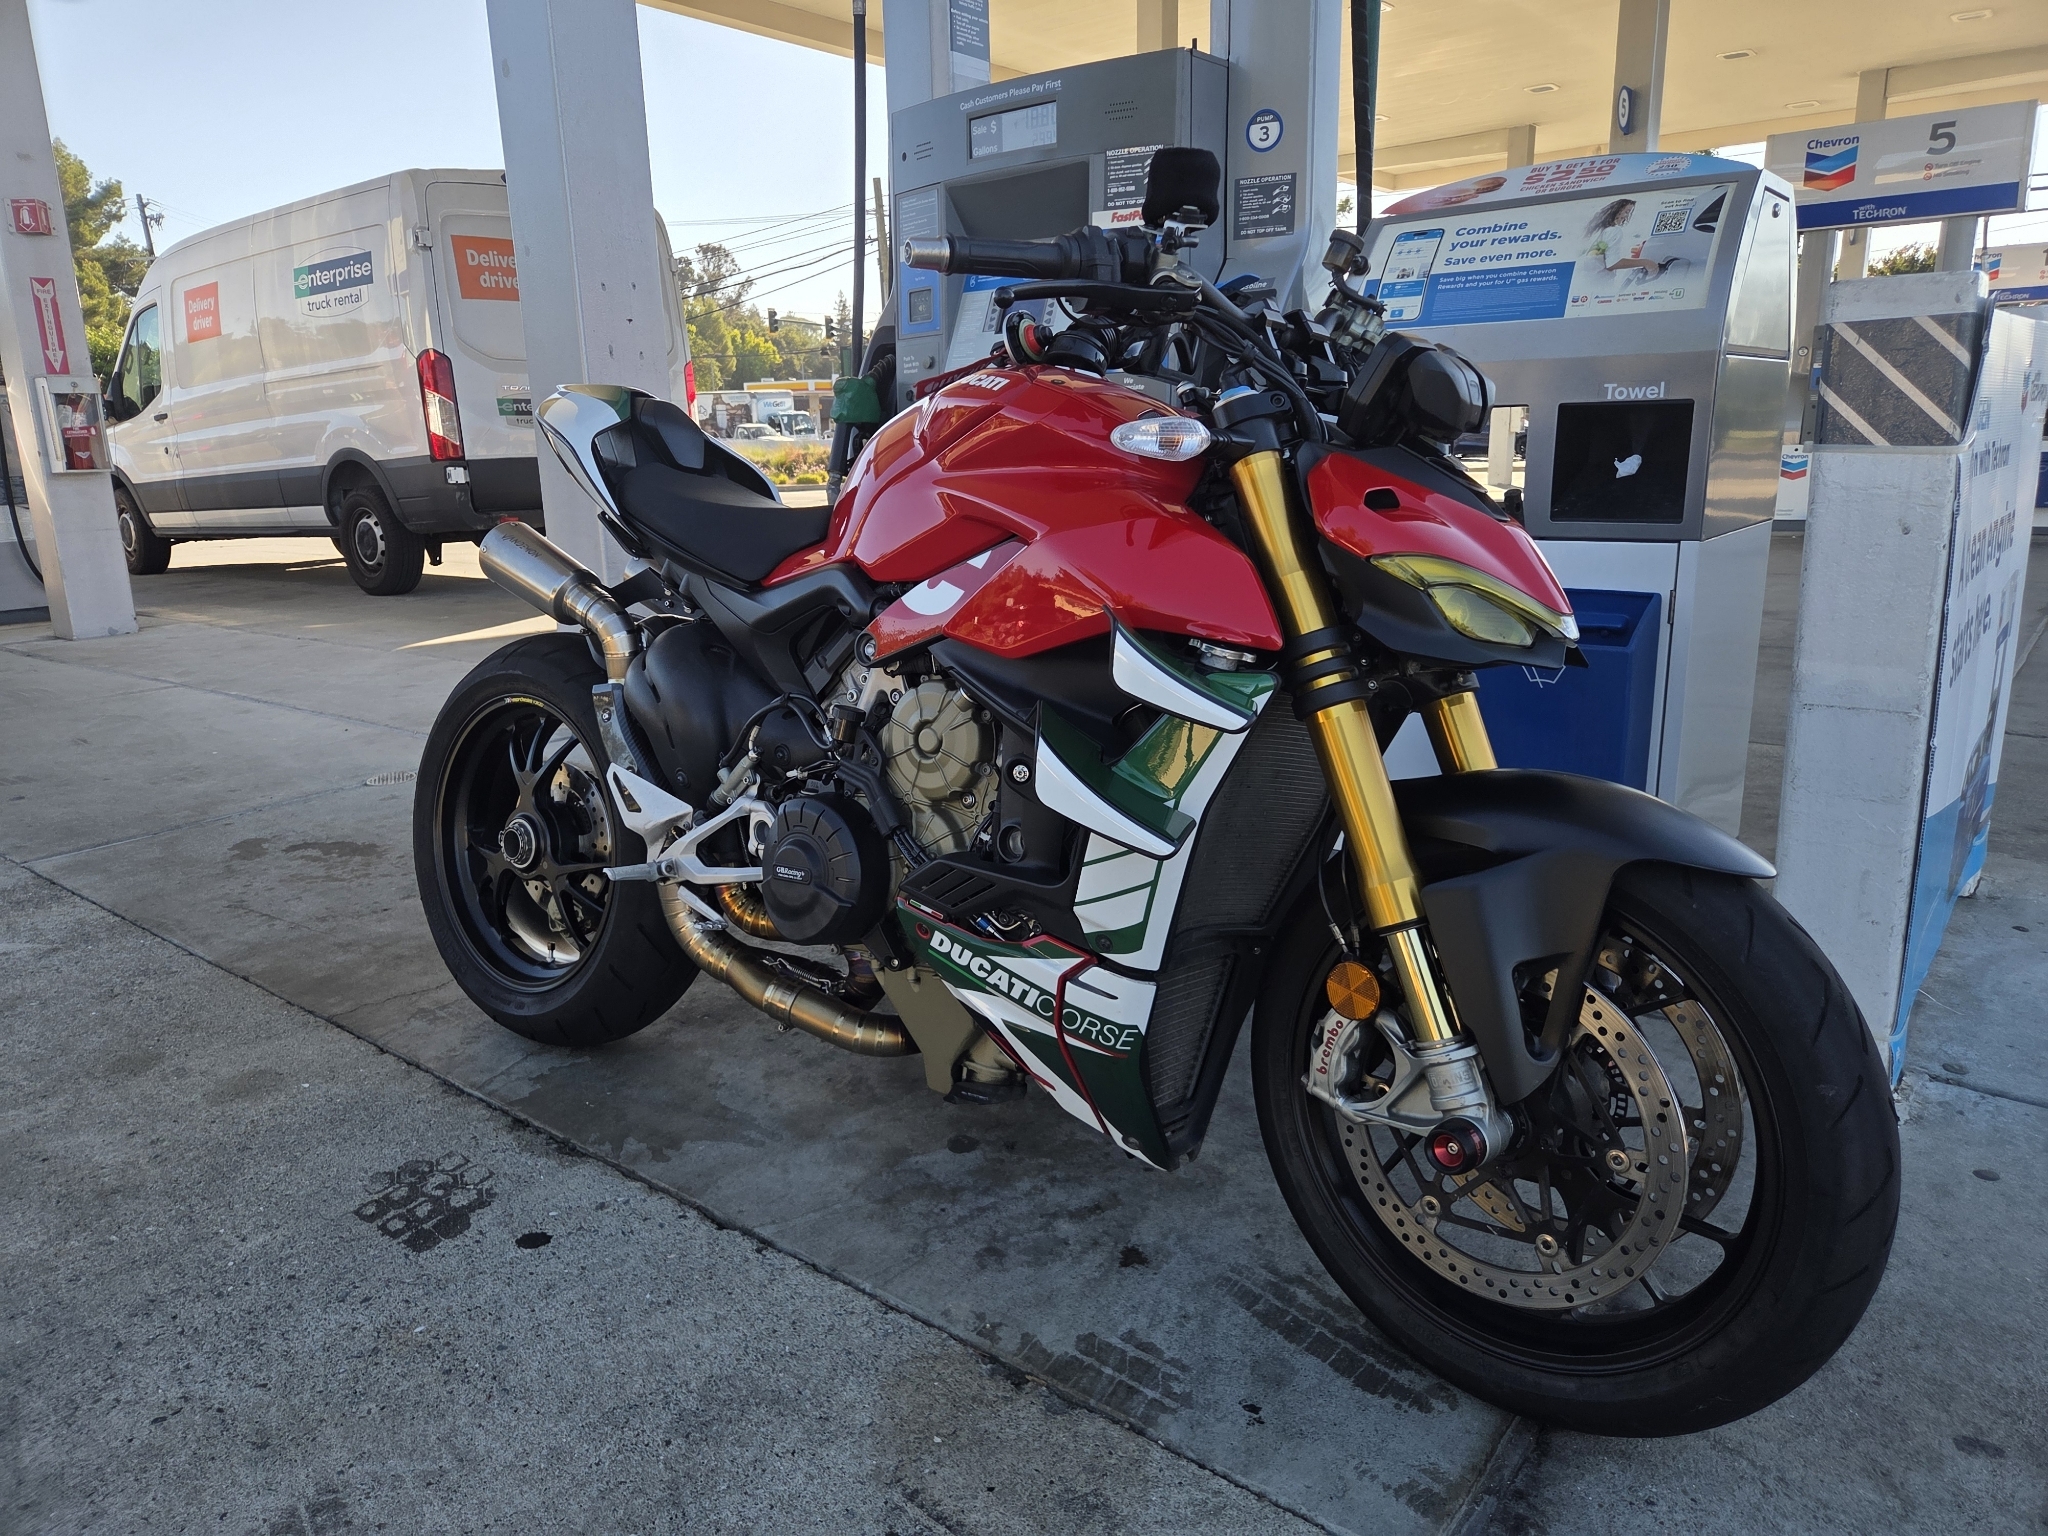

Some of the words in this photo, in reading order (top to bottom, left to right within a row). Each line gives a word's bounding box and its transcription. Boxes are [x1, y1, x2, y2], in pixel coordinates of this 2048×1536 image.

[960, 100, 974, 110] Cash
[975, 90, 1008, 105] Customers
[1010, 88, 1030, 97] Please
[1032, 84, 1044, 92] Pay
[1045, 80, 1061, 89] First
[973, 125, 987, 135] Sale
[990, 120, 997, 134] $
[1258, 126, 1269, 142] 3
[1807, 136, 1859, 150] Chevron
[1926, 120, 1957, 155] 5
[973, 144, 998, 156] Gallons
[1107, 148, 1129, 156] NOZZLE
[1130, 144, 1164, 154] OPERATION
[1519, 182, 1556, 192] CHICKEN
[1557, 177, 1606, 187] SANDWICH
[1548, 184, 1582, 192] BURGER
[1852, 207, 1907, 219] TECHRON
[1455, 222, 1528, 237] Combine
[1449, 239, 1487, 252] your
[1490, 230, 1562, 246] rewards.
[466, 249, 517, 268] Delive
[1444, 256, 1476, 266] Save
[1480, 252, 1512, 263] even
[1516, 249, 1557, 259] more.
[295, 261, 372, 290] enterprise
[479, 271, 519, 289] drive
[1437, 282, 1464, 290] Rewards
[1530, 275, 1559, 283] rewards.
[188, 296, 215, 314] Delivery
[307, 295, 332, 312] truck
[334, 288, 362, 307] rental
[43, 298, 59, 363] EXTINGUISHER
[192, 315, 213, 331] driver
[1604, 381, 1665, 400] Towel
[499, 402, 532, 411] ente
[1987, 501, 2016, 568] engine
[1949, 609, 1973, 688] starts
[776, 866, 803, 878] GBRacing
[1316, 1019, 1344, 1075] brembo
